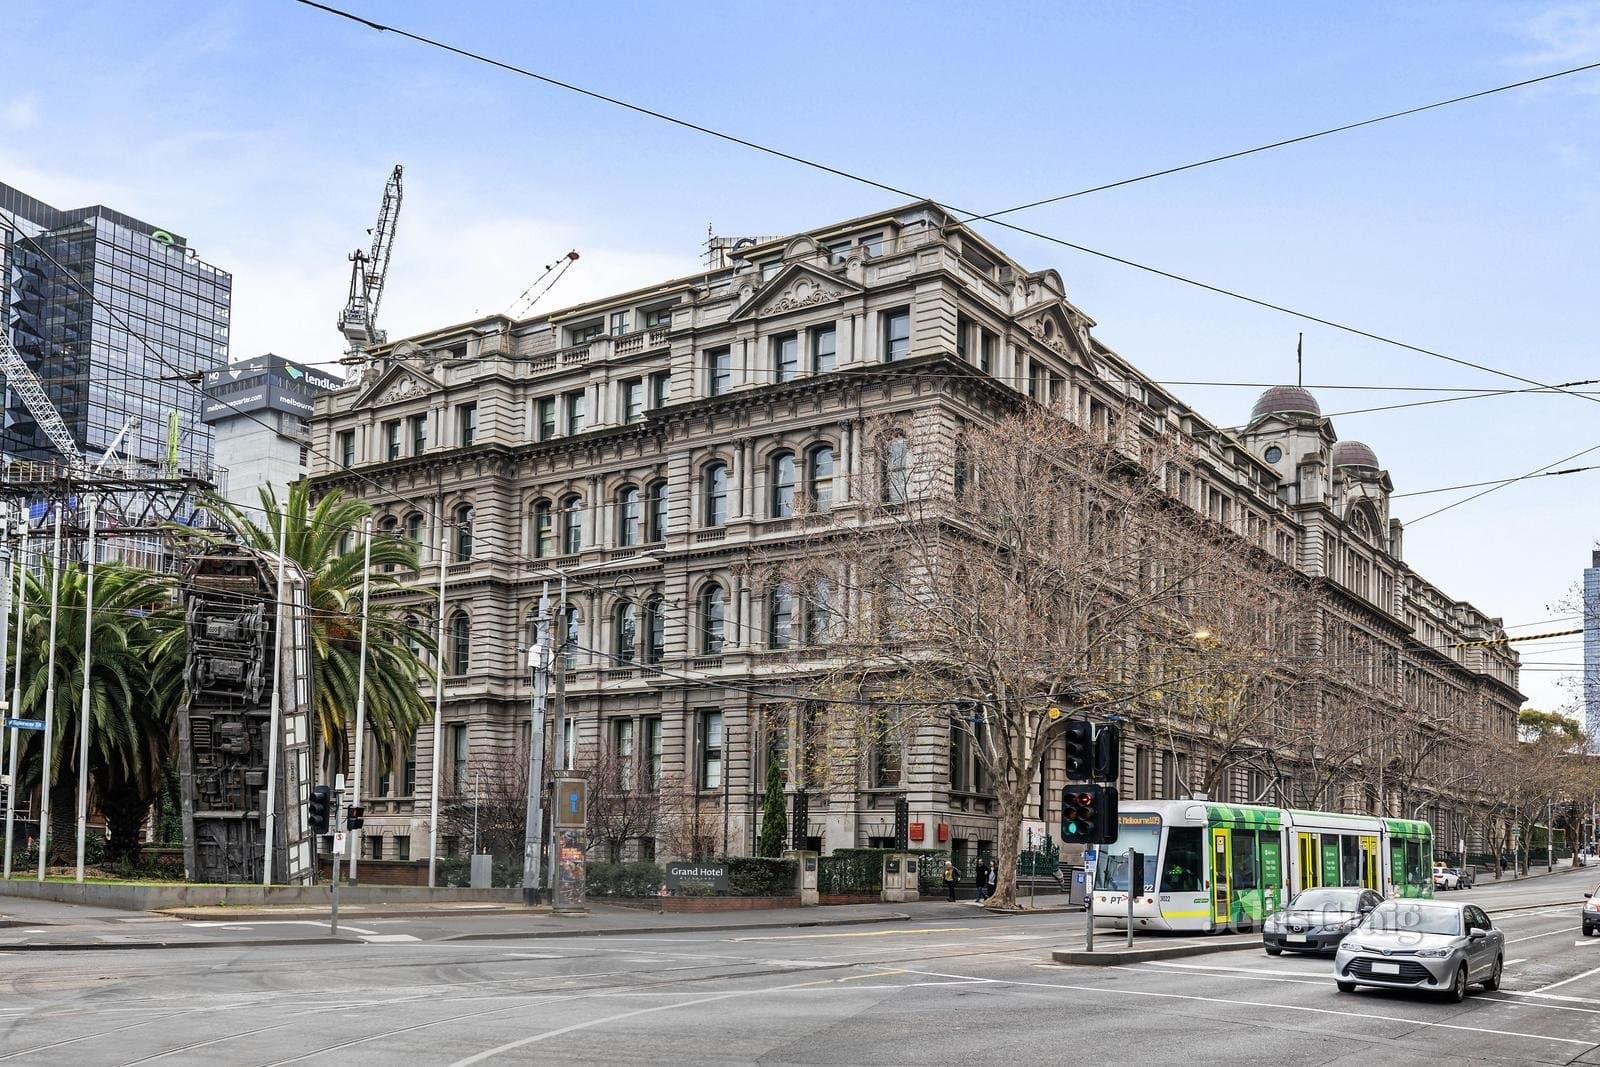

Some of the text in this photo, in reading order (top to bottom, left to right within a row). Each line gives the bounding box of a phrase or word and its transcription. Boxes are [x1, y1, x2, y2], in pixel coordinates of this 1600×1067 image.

[671, 867, 723, 877] Grand Hotel
[1144, 884, 1154, 892] 22
